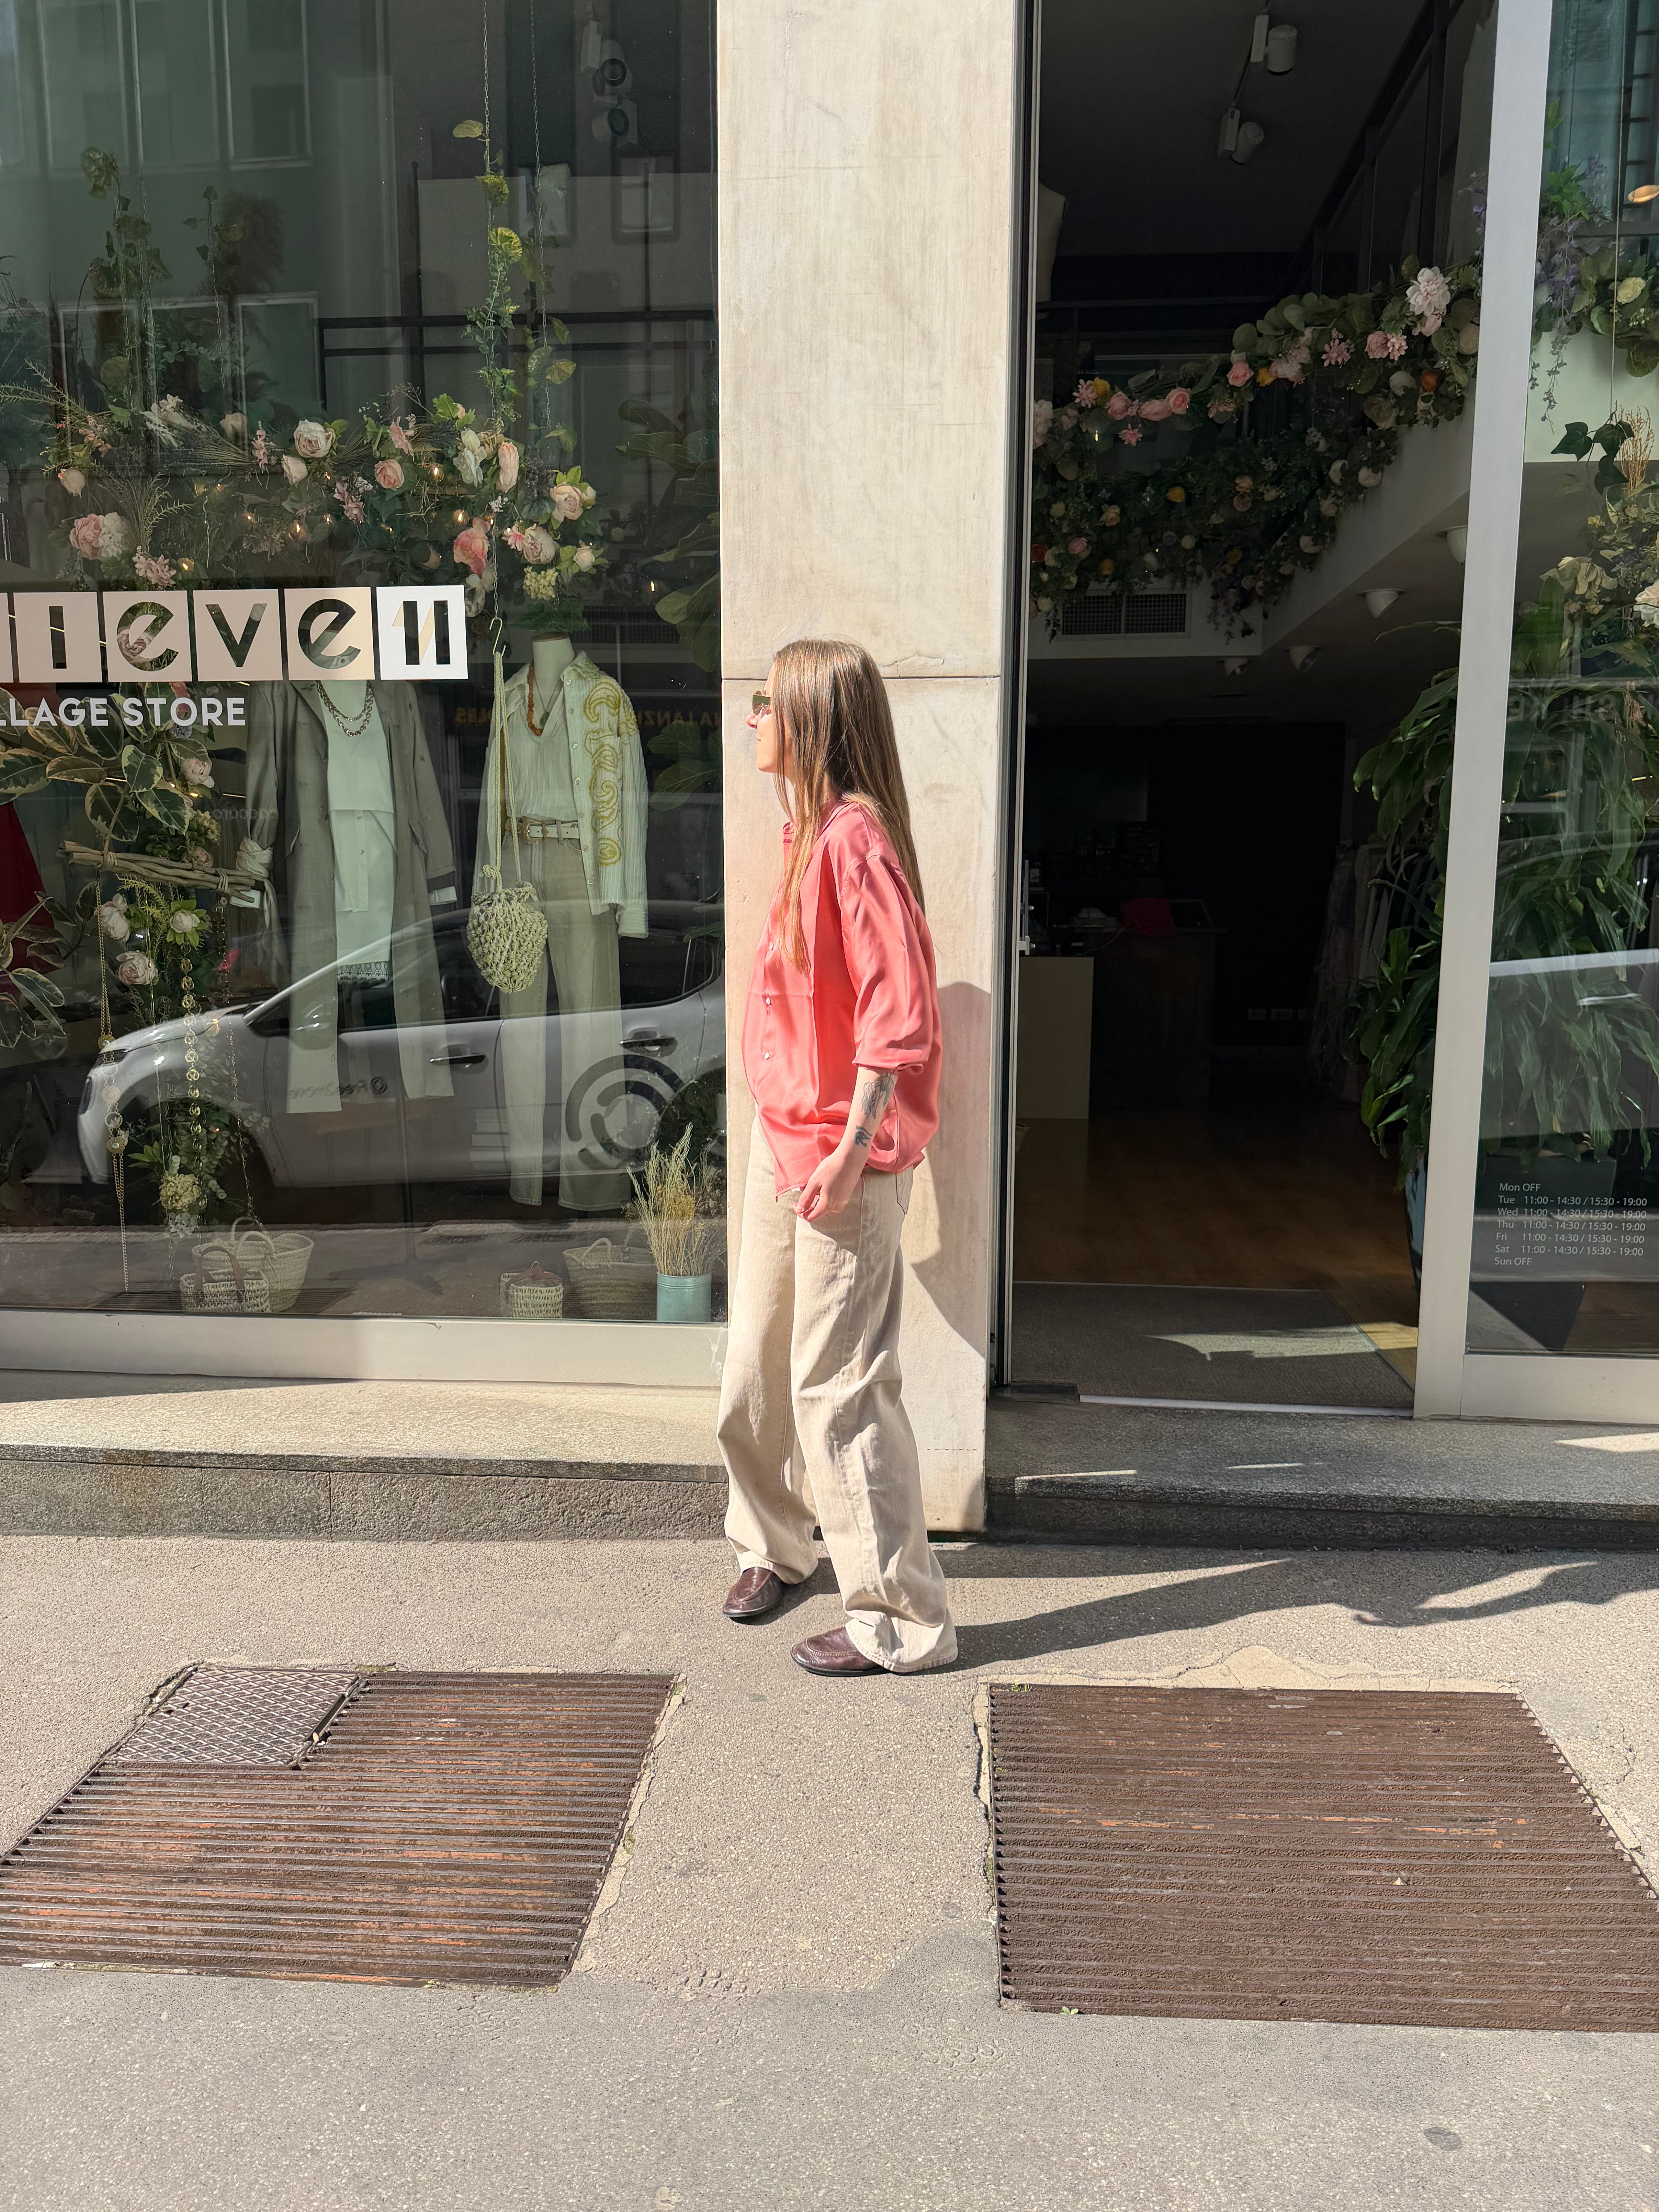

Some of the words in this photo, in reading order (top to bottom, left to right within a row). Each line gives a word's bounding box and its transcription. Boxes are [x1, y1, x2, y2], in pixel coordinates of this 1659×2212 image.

[123, 697, 246, 726] STORE
[1499, 1183, 1520, 1191] Mon
[1522, 1183, 1541, 1192] OFF
[1498, 1195, 1515, 1204] Tue
[1557, 1197, 1581, 1205] 14:30
[1590, 1197, 1614, 1206] 15:30
[1623, 1198, 1647, 1206] 19:00
[1498, 1207, 1518, 1216] Wed
[1557, 1209, 1580, 1217] 14:30
[1589, 1210, 1613, 1218] 15:30
[1498, 1220, 1514, 1228] Thu
[1523, 1221, 1547, 1229] 11:00
[1556, 1221, 1579, 1230] 14:30
[1589, 1222, 1613, 1230] 15:30
[1555, 1234, 1578, 1242] 14:30
[1495, 1245, 1509, 1253] Sat
[1554, 1246, 1578, 1254] 14:30
[1587, 1247, 1611, 1255] 15:30
[1620, 1247, 1644, 1256] 19:00
